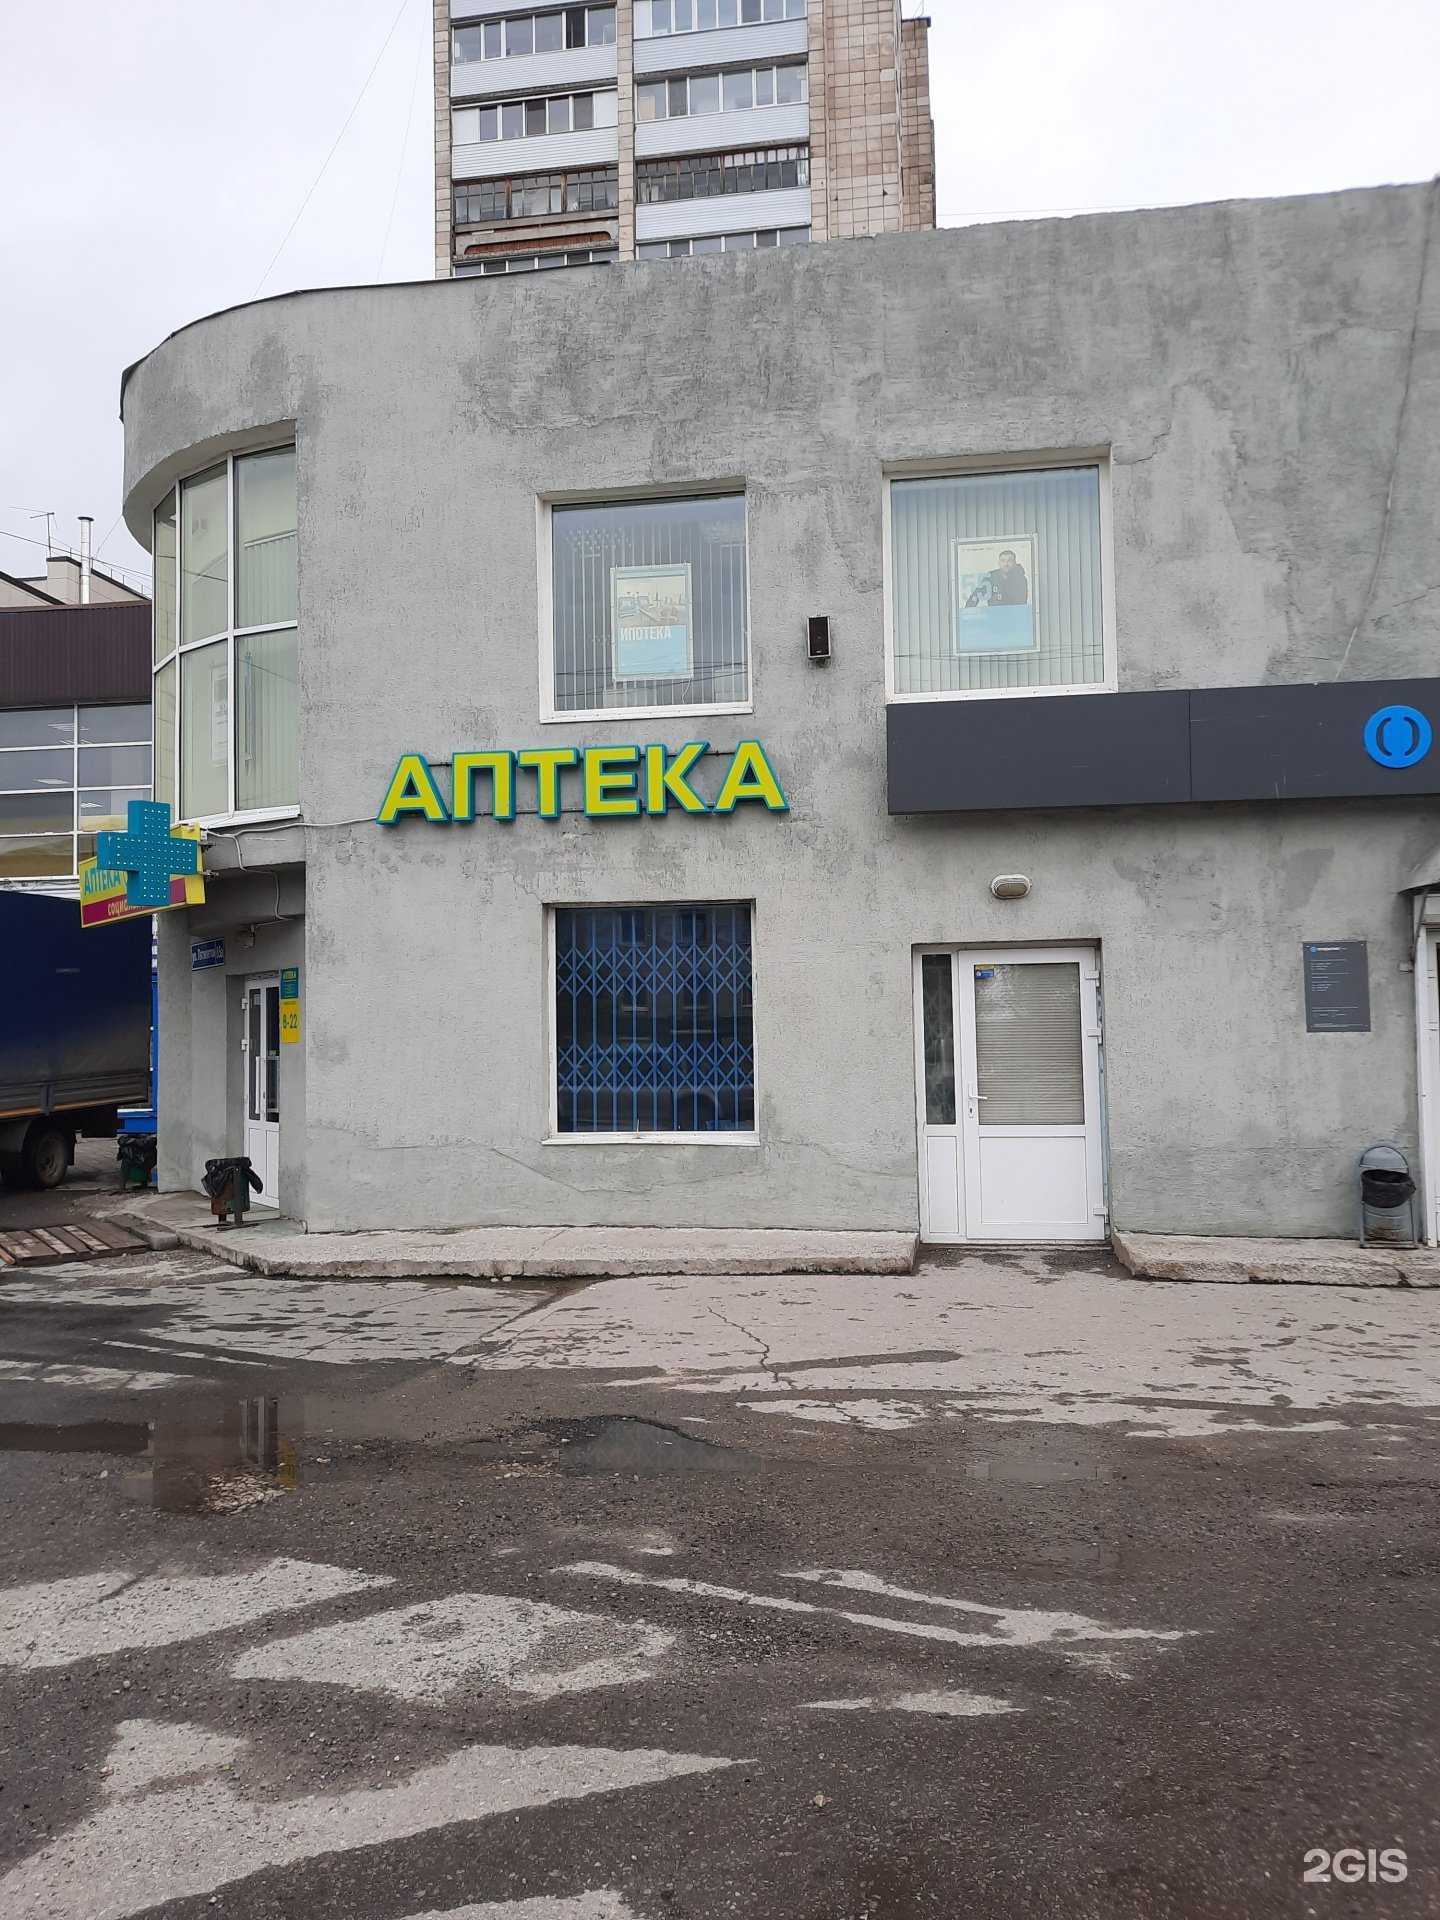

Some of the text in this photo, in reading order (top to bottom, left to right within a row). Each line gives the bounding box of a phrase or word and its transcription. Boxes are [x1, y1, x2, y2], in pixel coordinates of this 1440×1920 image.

[621, 626, 672, 640] ИПОТЕКА
[376, 740, 791, 825] АПТЕКА
[84, 867, 122, 896] АПТЕКА
